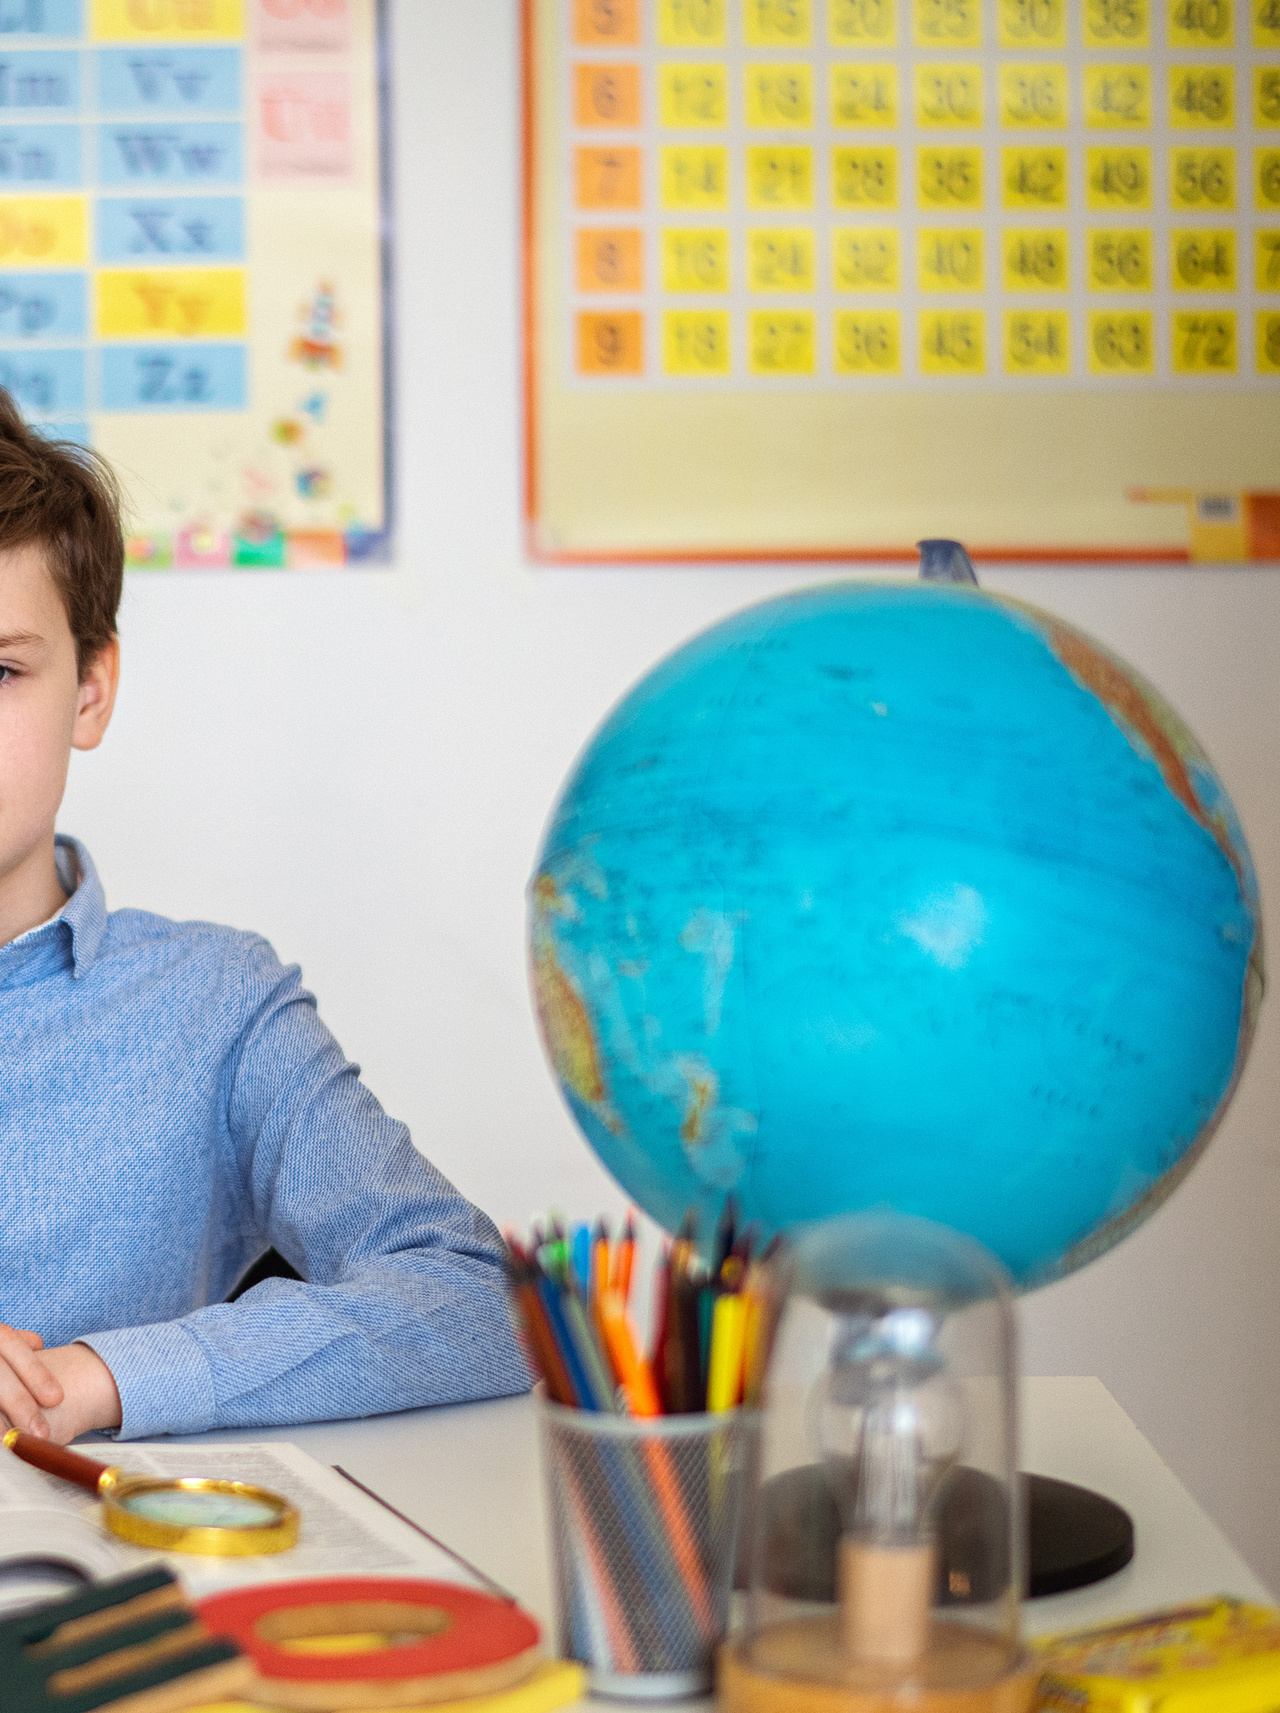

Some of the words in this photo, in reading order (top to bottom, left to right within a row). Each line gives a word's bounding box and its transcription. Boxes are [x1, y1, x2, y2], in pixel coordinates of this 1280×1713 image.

[127, 58, 210, 101] Vv
[673, 74, 720, 120] 12
[757, 74, 806, 120] 18
[840, 74, 890, 120] 24
[925, 74, 975, 120] 30
[1009, 74, 1060, 120] 36
[1094, 74, 1145, 120] 42
[1177, 74, 1229, 120] 48
[112, 132, 225, 176] Ww
[674, 156, 721, 201] 14
[758, 156, 807, 201] 21
[841, 156, 891, 201] 28
[926, 156, 976, 201] 35
[1010, 156, 1061, 201] 42
[1095, 156, 1146, 201] 49
[1178, 156, 1230, 201] 56
[129, 207, 216, 253] Xx
[675, 239, 722, 284] 16
[759, 239, 808, 284] 24
[842, 239, 892, 284] 32
[927, 239, 977, 284] 40
[1011, 239, 1062, 284] 48
[1096, 239, 1147, 284] 56
[1179, 239, 1231, 284] 64
[131, 282, 215, 336] Yy
[676, 321, 723, 366] 18
[760, 321, 809, 366] 27
[843, 321, 893, 366] 36
[928, 321, 978, 366] 45
[1012, 321, 1063, 366] 54
[1097, 321, 1148, 366] 63
[1180, 321, 1232, 366] 72
[135, 354, 212, 403] Zz
